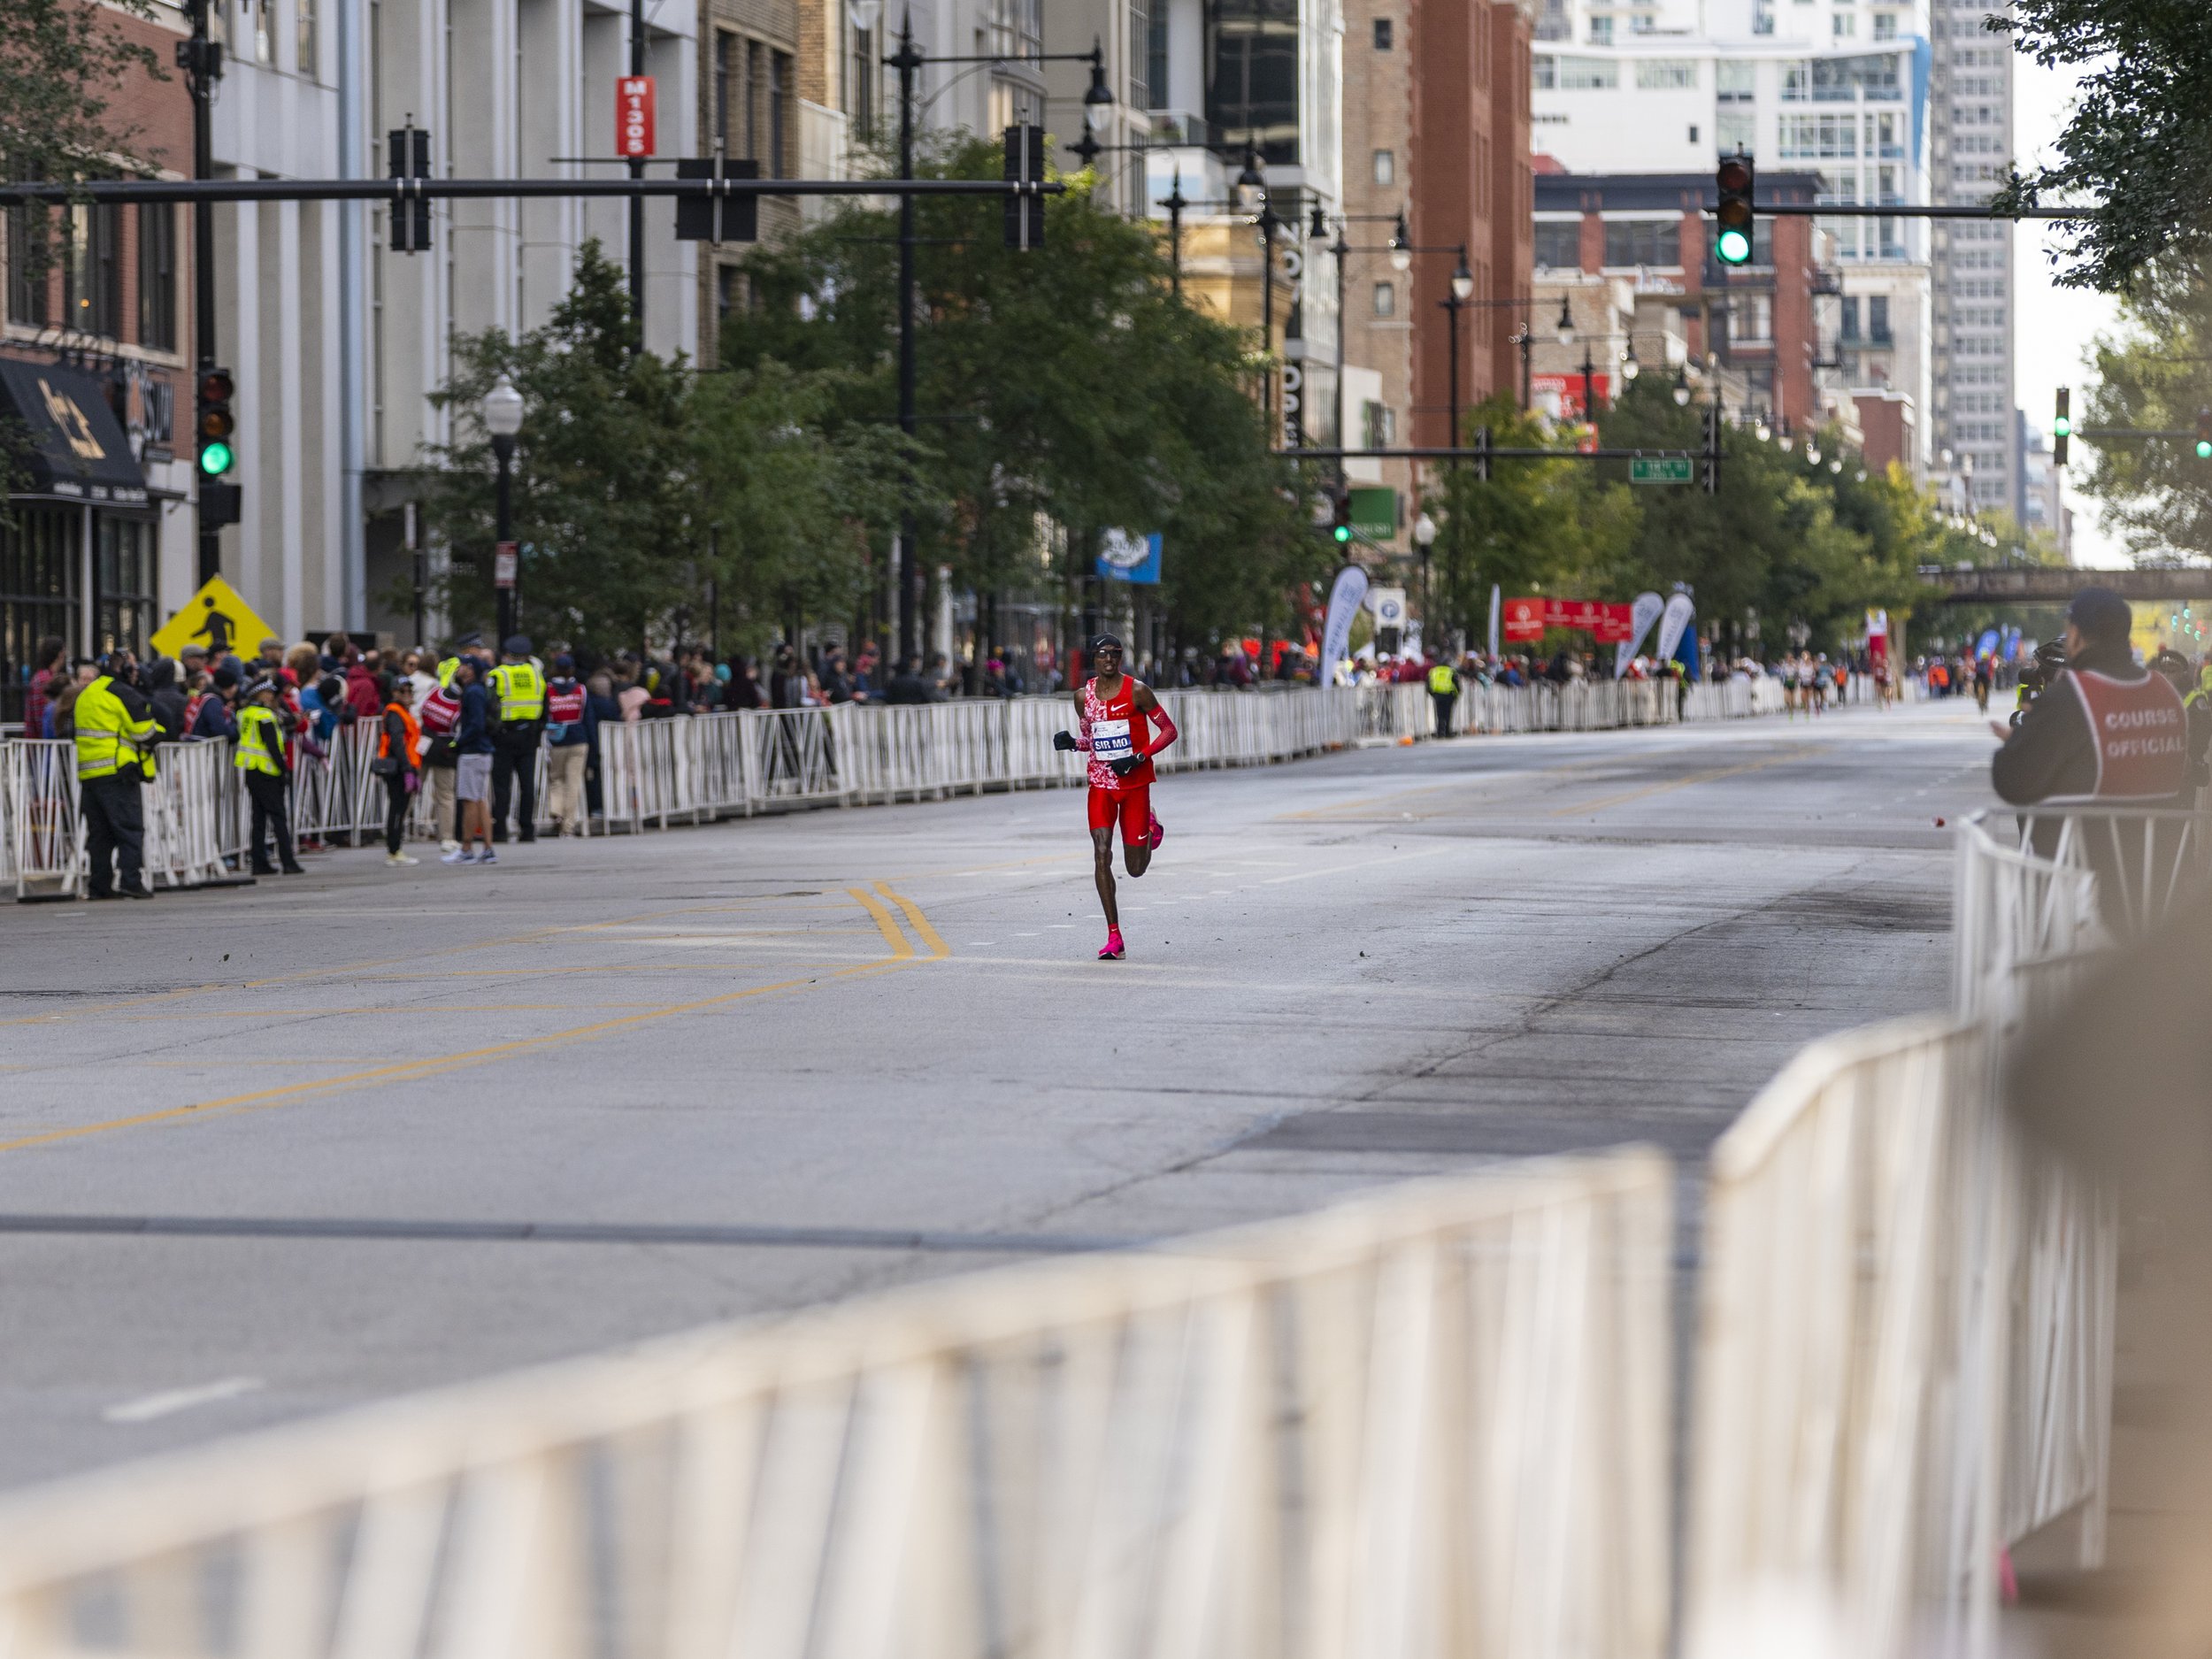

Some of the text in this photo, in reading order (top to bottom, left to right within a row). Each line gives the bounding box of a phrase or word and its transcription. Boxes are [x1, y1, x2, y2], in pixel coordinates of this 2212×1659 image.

[2105, 709, 2178, 729] COURSE
[1094, 737, 1128, 750] SIR MO
[2107, 735, 2184, 756] OFFICIAL
